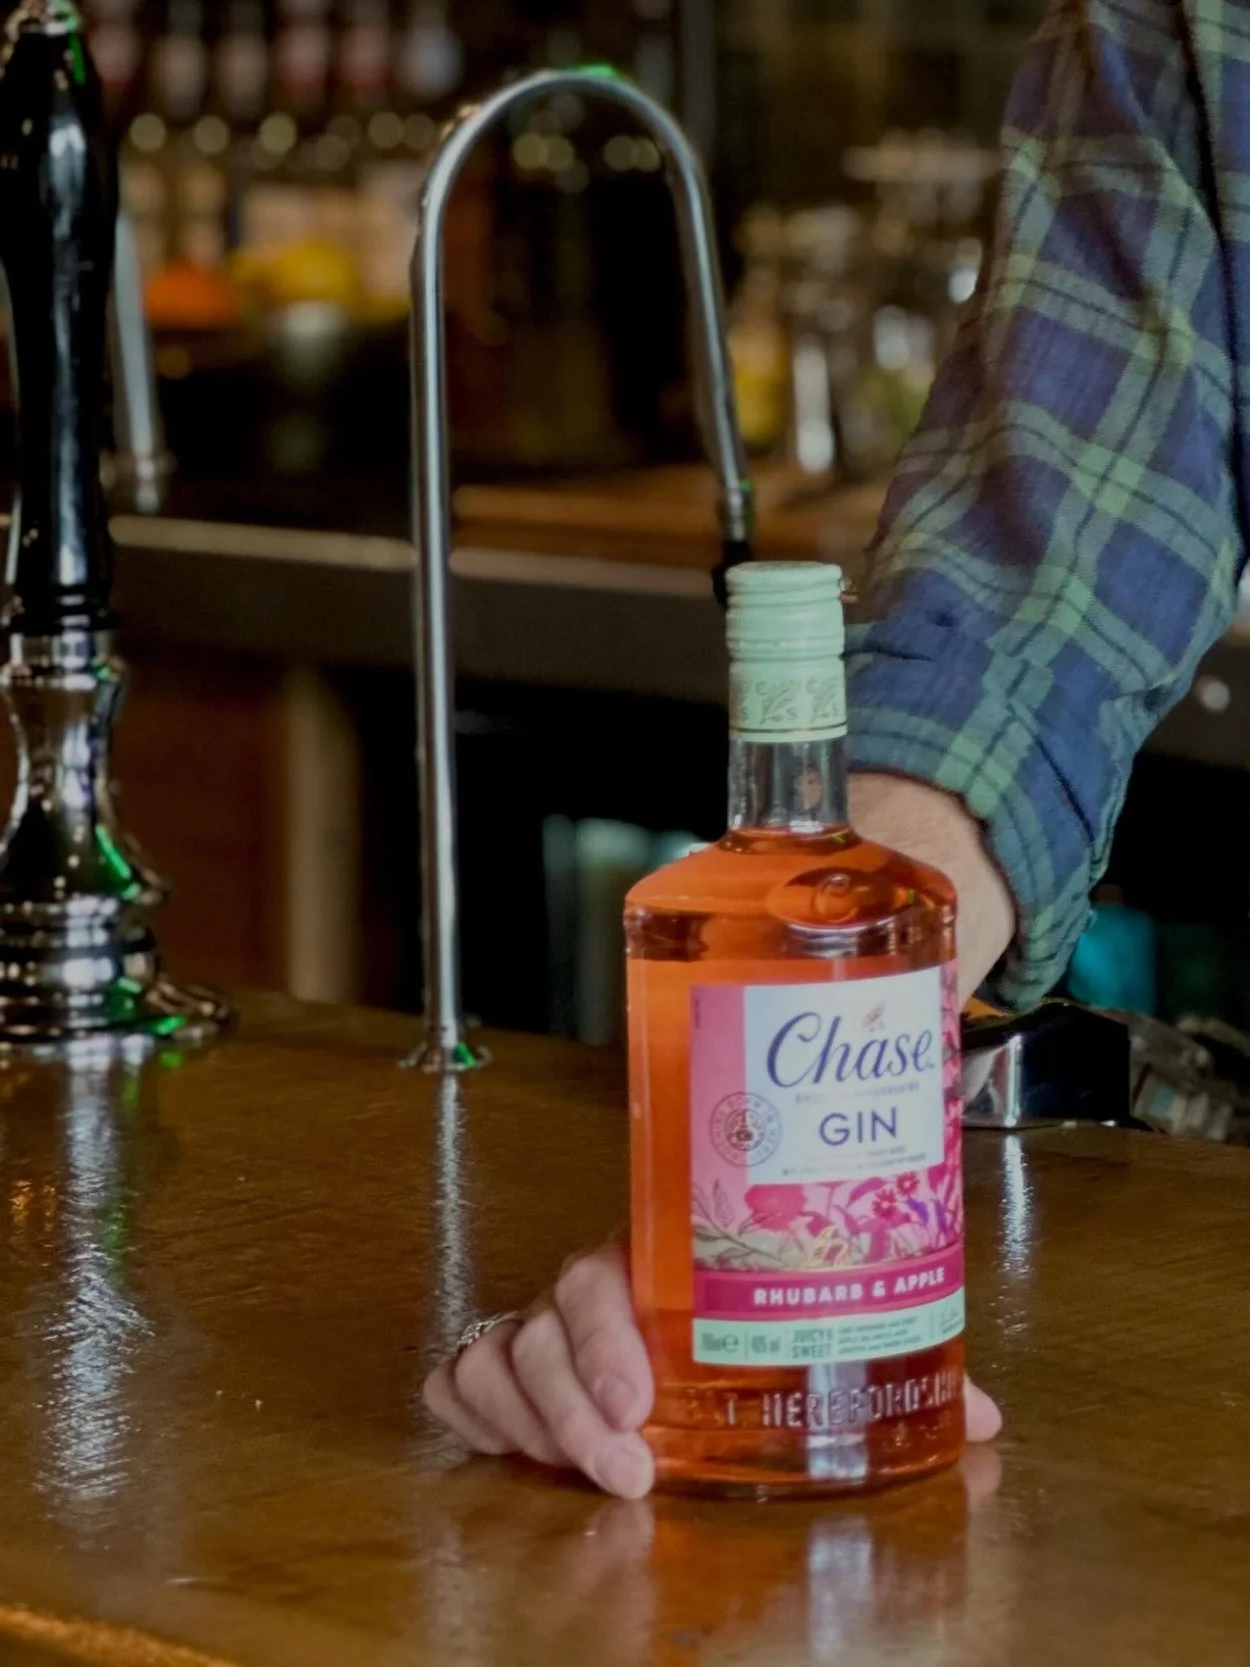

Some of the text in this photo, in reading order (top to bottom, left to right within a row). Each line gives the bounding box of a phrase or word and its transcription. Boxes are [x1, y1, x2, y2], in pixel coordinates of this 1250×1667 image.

[767, 1011, 932, 1088] Chase
[819, 1106, 897, 1146] GIN
[754, 1267, 945, 1306] RHUBARB & APPLE
